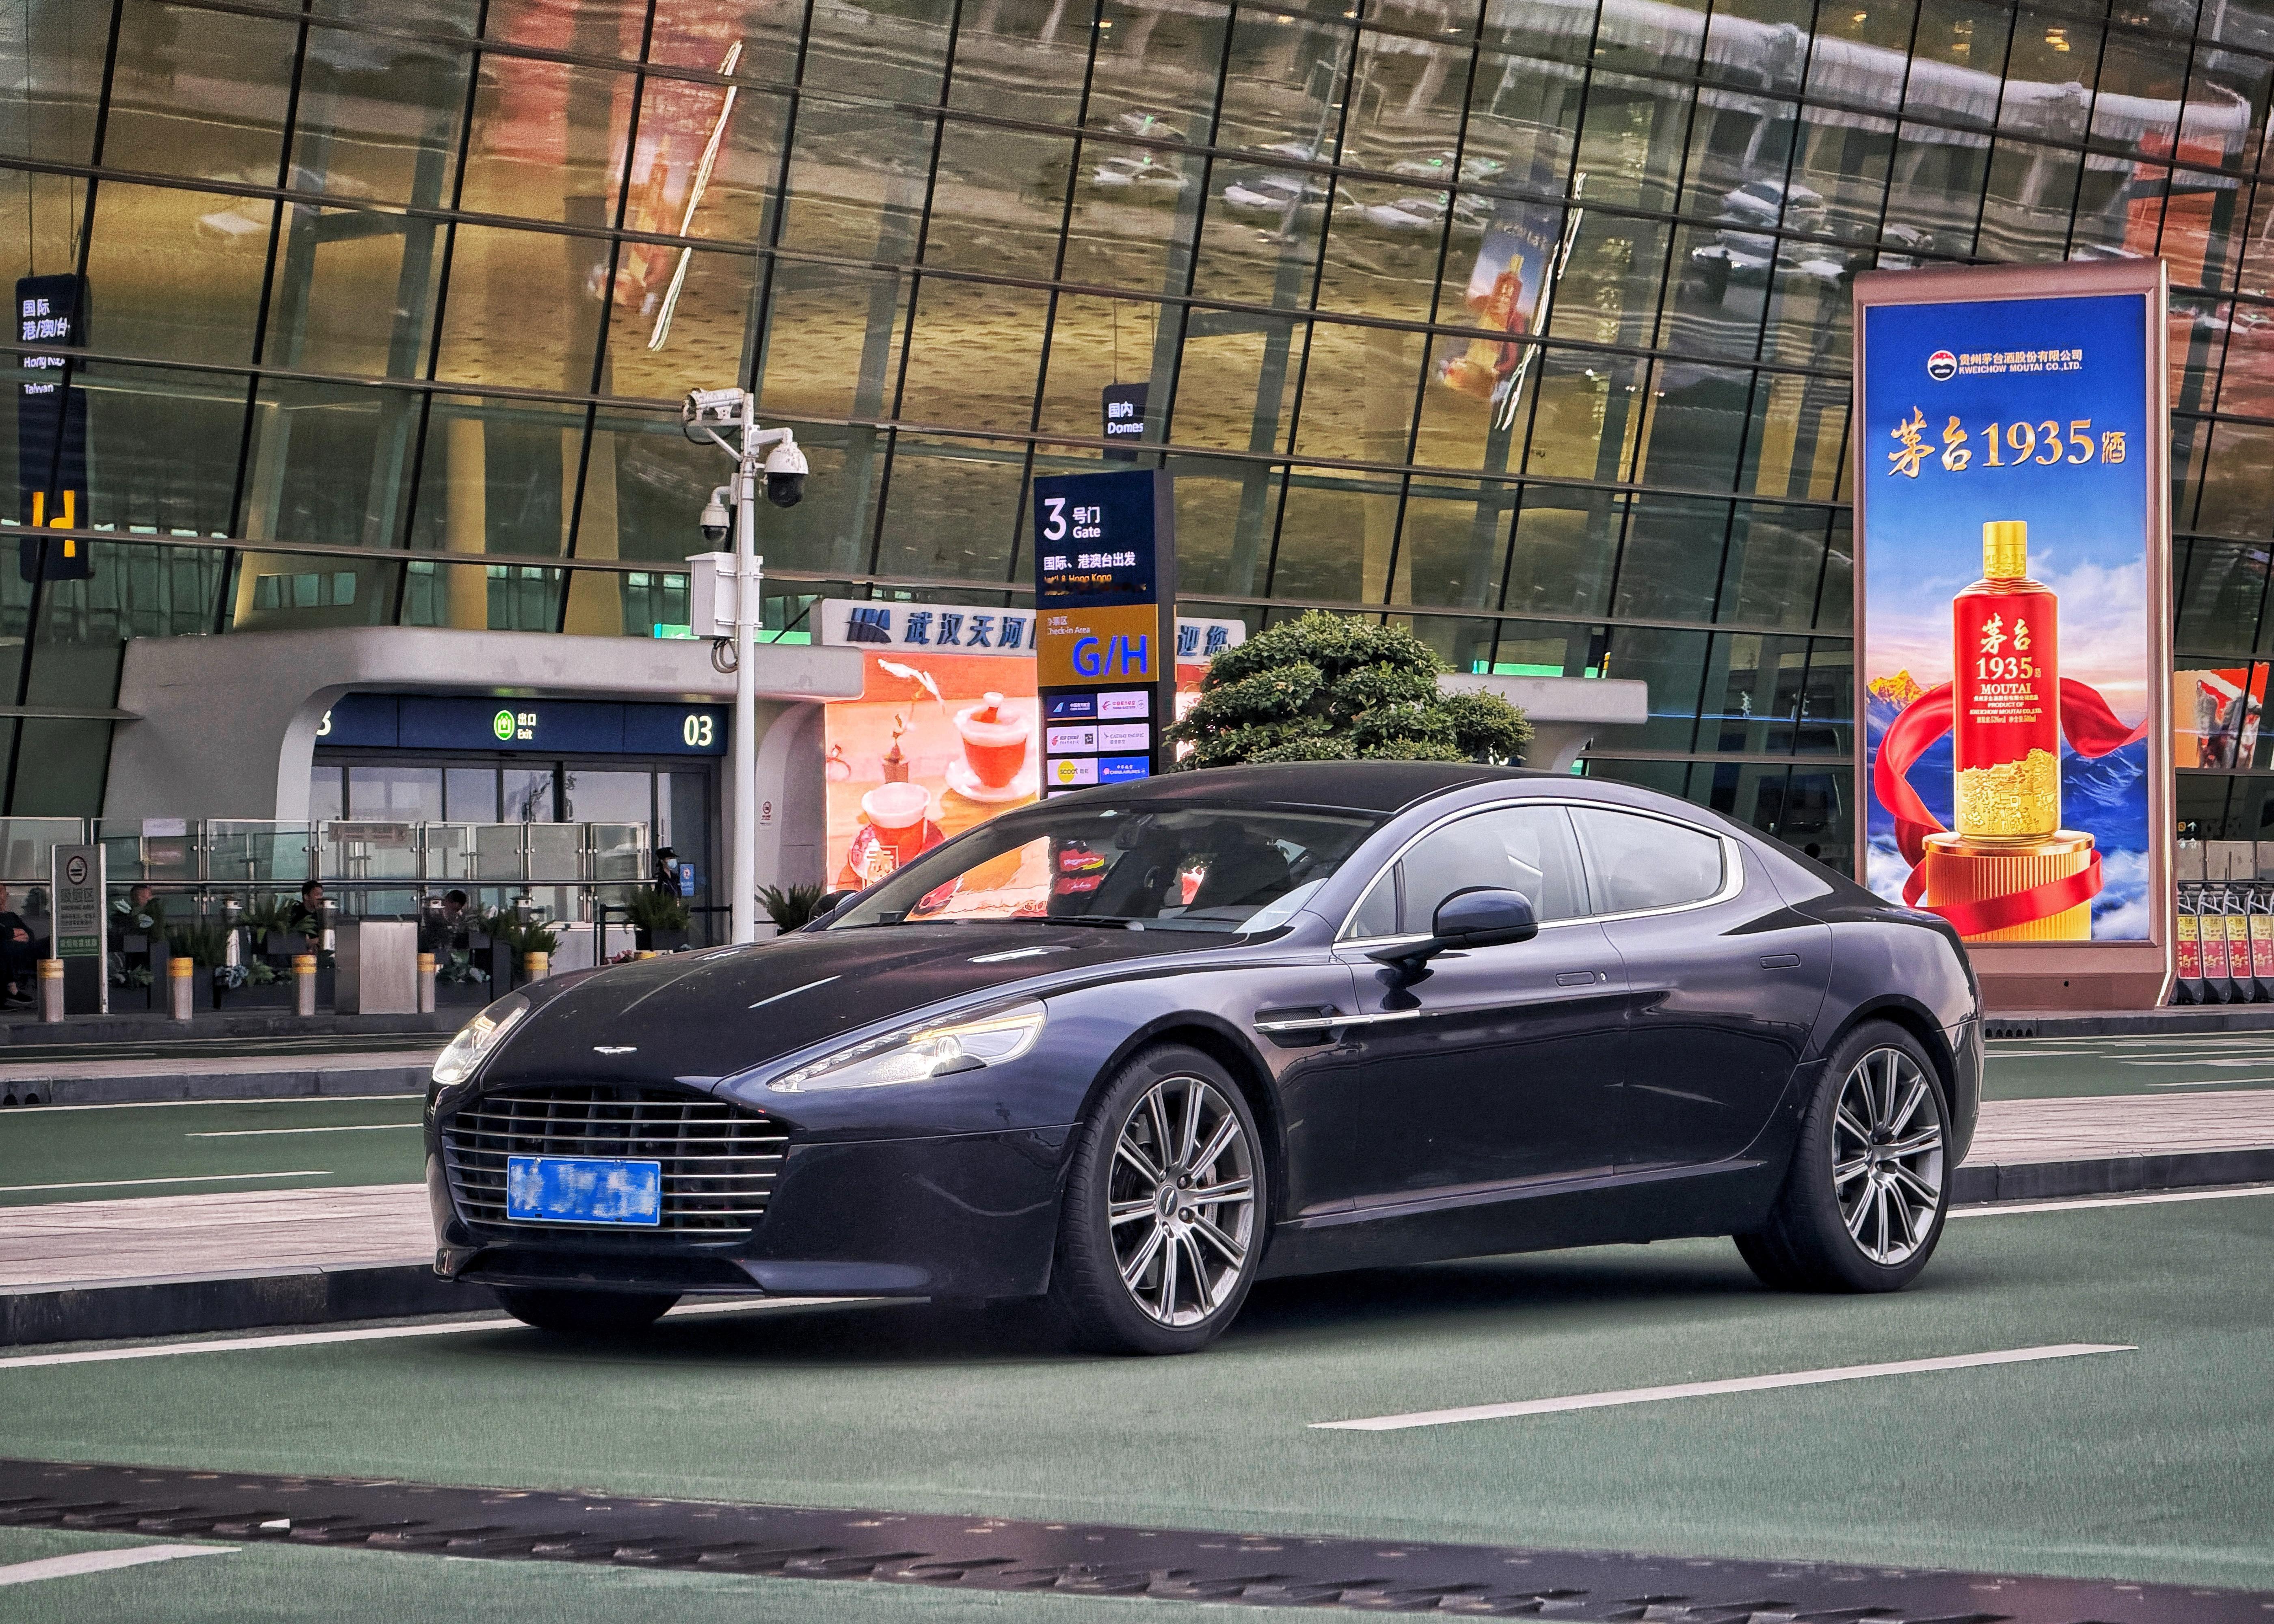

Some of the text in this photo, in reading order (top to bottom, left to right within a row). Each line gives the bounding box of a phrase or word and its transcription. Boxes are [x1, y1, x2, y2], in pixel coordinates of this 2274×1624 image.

[23, 299, 50, 317] 国际
[1959, 350, 2082, 365] 贵州茅台酒股份有限公司
[1958, 365, 2006, 374] KWEICHOW
[2010, 363, 2043, 372] MOUTAI
[1108, 402, 1133, 418] 国内
[1043, 497, 1067, 541] 3
[1072, 507, 1100, 524] 号门
[1072, 526, 1101, 539] Gate
[1043, 552, 1136, 570] 国际、港澳台出发
[1980, 612, 2031, 655] 茅台
[1072, 634, 1148, 677] G/H
[1980, 683, 2032, 695] MOUTAI
[518, 713, 536, 726] 出口
[518, 729, 533, 739] Exit
[684, 715, 712, 746] 03
